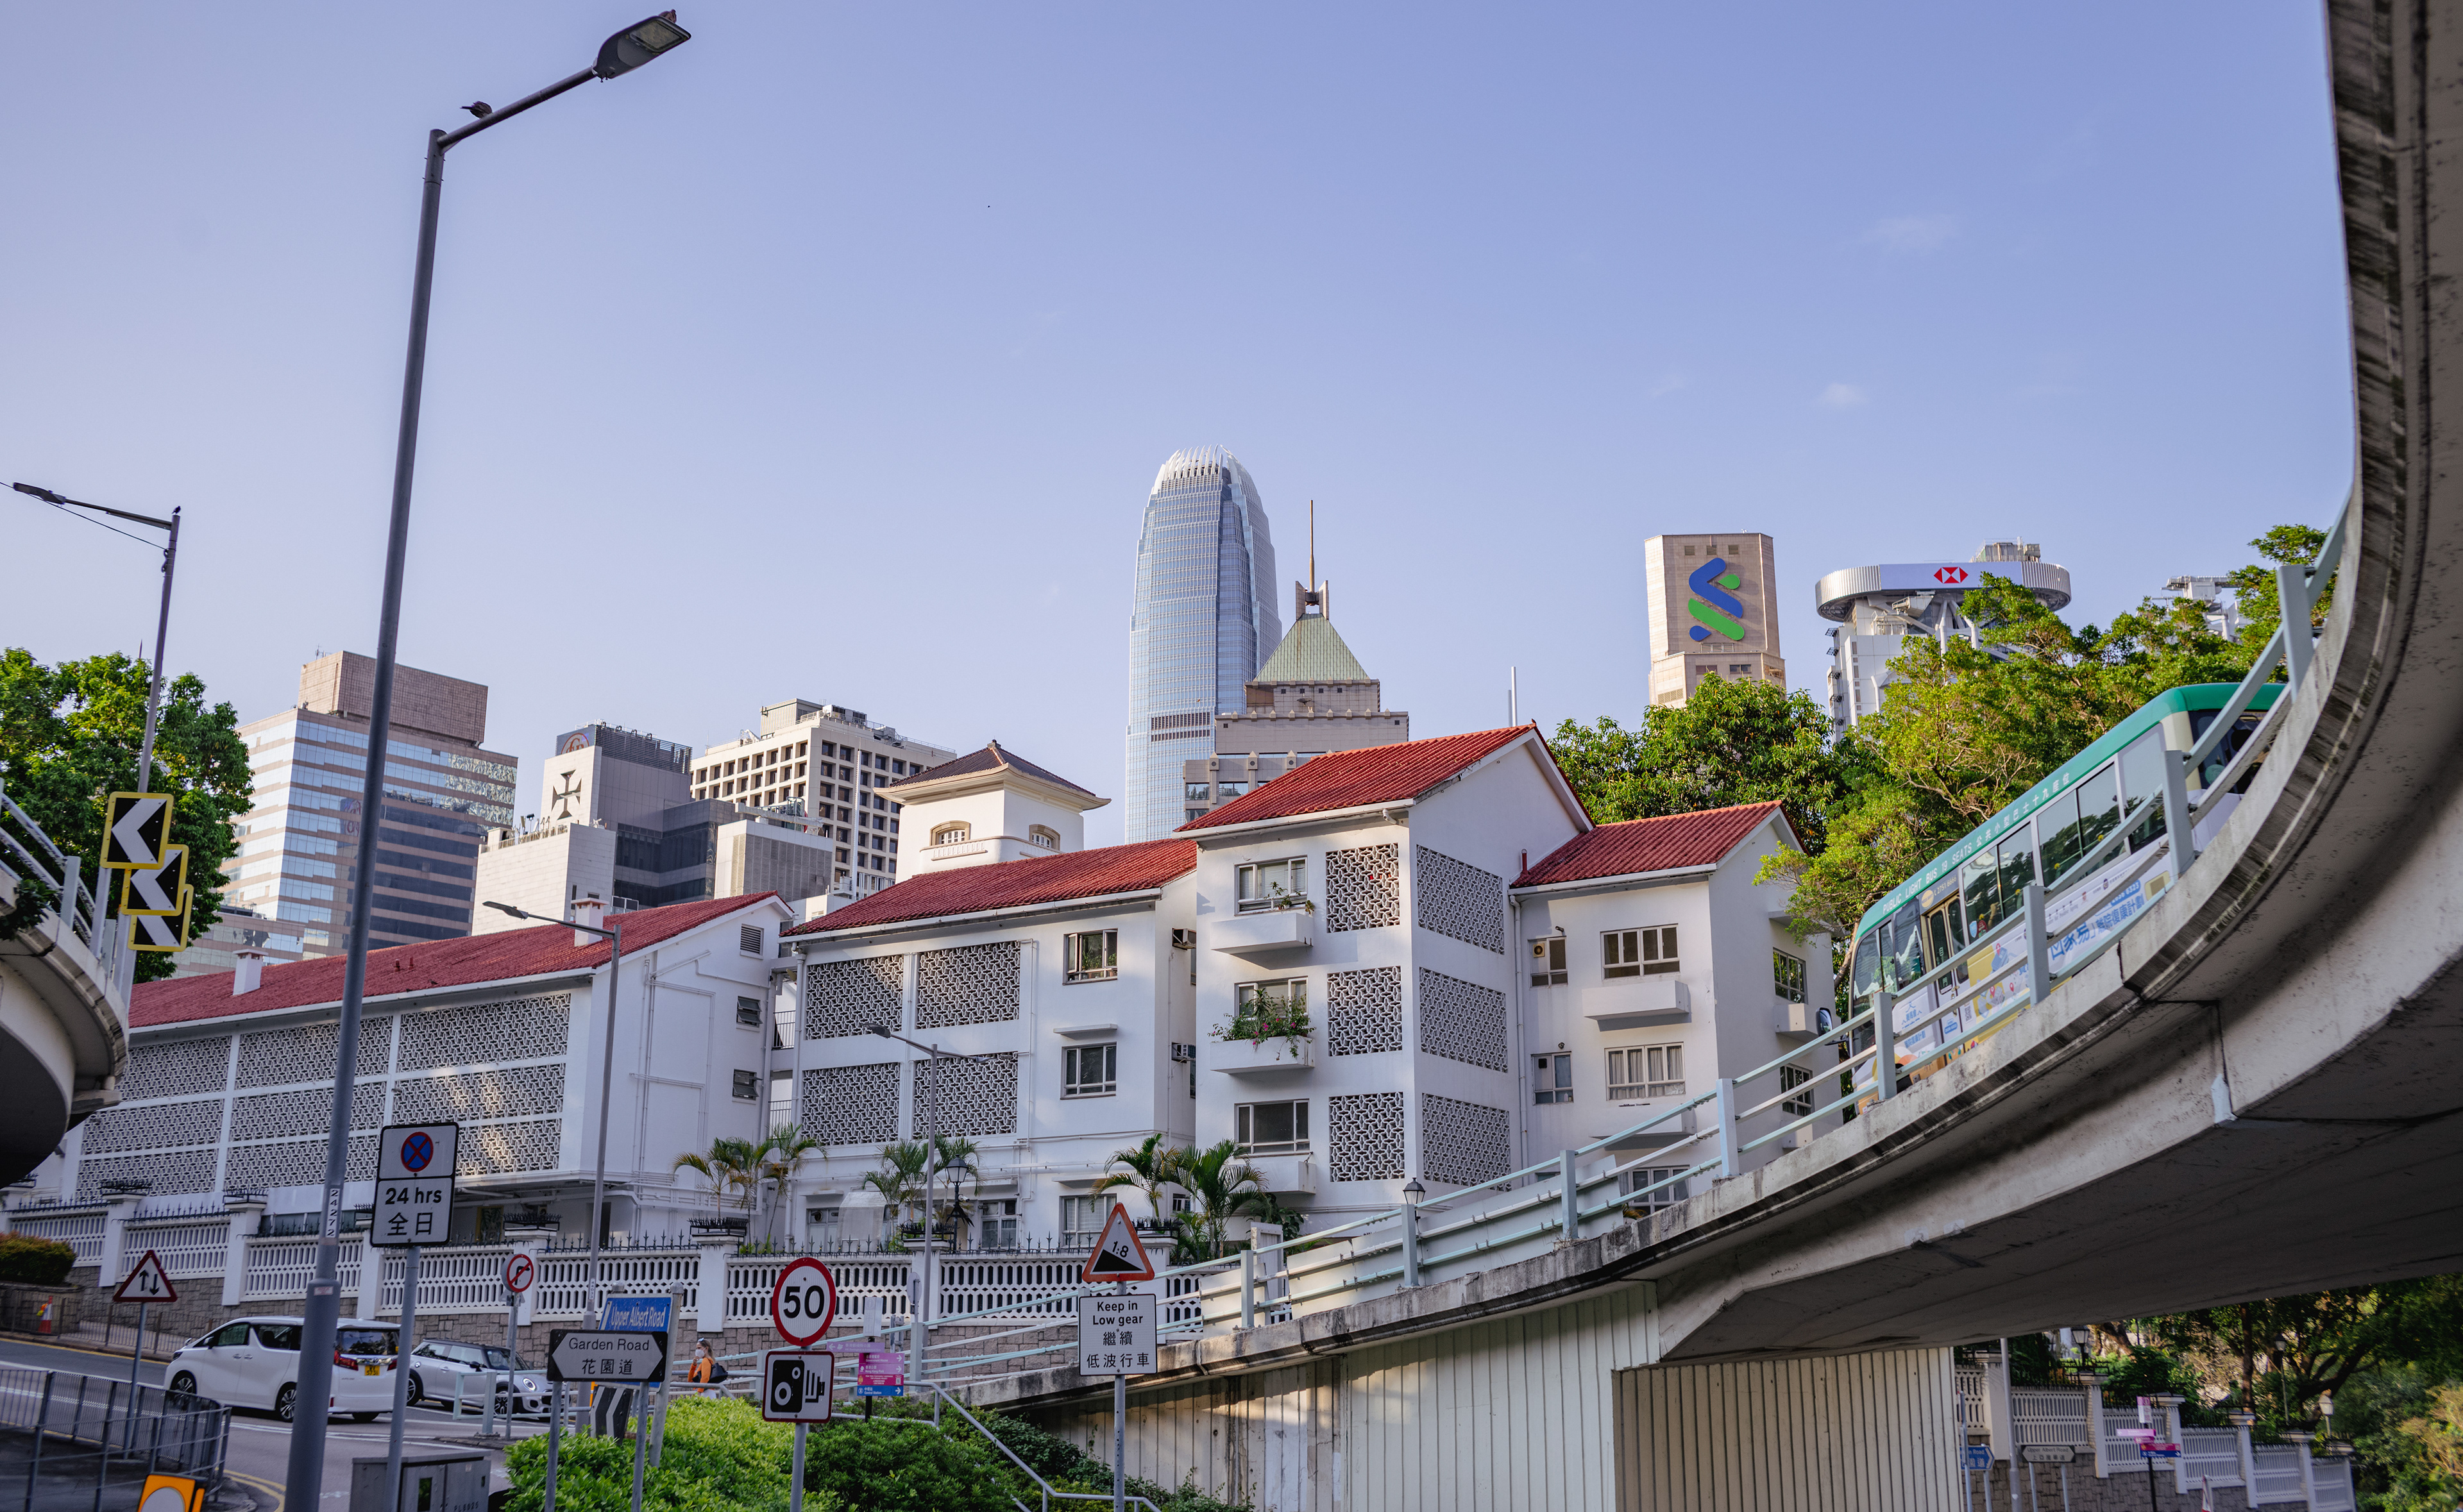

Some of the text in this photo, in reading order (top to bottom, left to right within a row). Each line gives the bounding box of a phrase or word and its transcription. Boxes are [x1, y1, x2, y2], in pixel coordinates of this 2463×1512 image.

[1976, 772, 2070, 847] 公共小型巴士十九座位
[1883, 893, 1902, 914] PUBLIC
[1905, 878, 1922, 898] LIGHT
[1926, 868, 1938, 884] BUS
[1941, 860, 1948, 873] 19
[1952, 842, 1972, 865] SEATS
[1937, 883, 1947, 895] 2751
[385, 1187, 443, 1205] 24 hrs
[326, 1189, 339, 1236] 24272
[387, 1212, 433, 1236] 全日
[1111, 1241, 1129, 1258] 1:8
[783, 1285, 825, 1319] 50
[1097, 1300, 1138, 1313] Keep in
[611, 1306, 666, 1329] Upper Albert Road
[1092, 1315, 1144, 1327] Low gear
[568, 1337, 650, 1351] Garden Road
[1103, 1331, 1133, 1346] 繼續
[582, 1358, 633, 1375] 花園道
[1087, 1352, 1149, 1368] 低波行車
